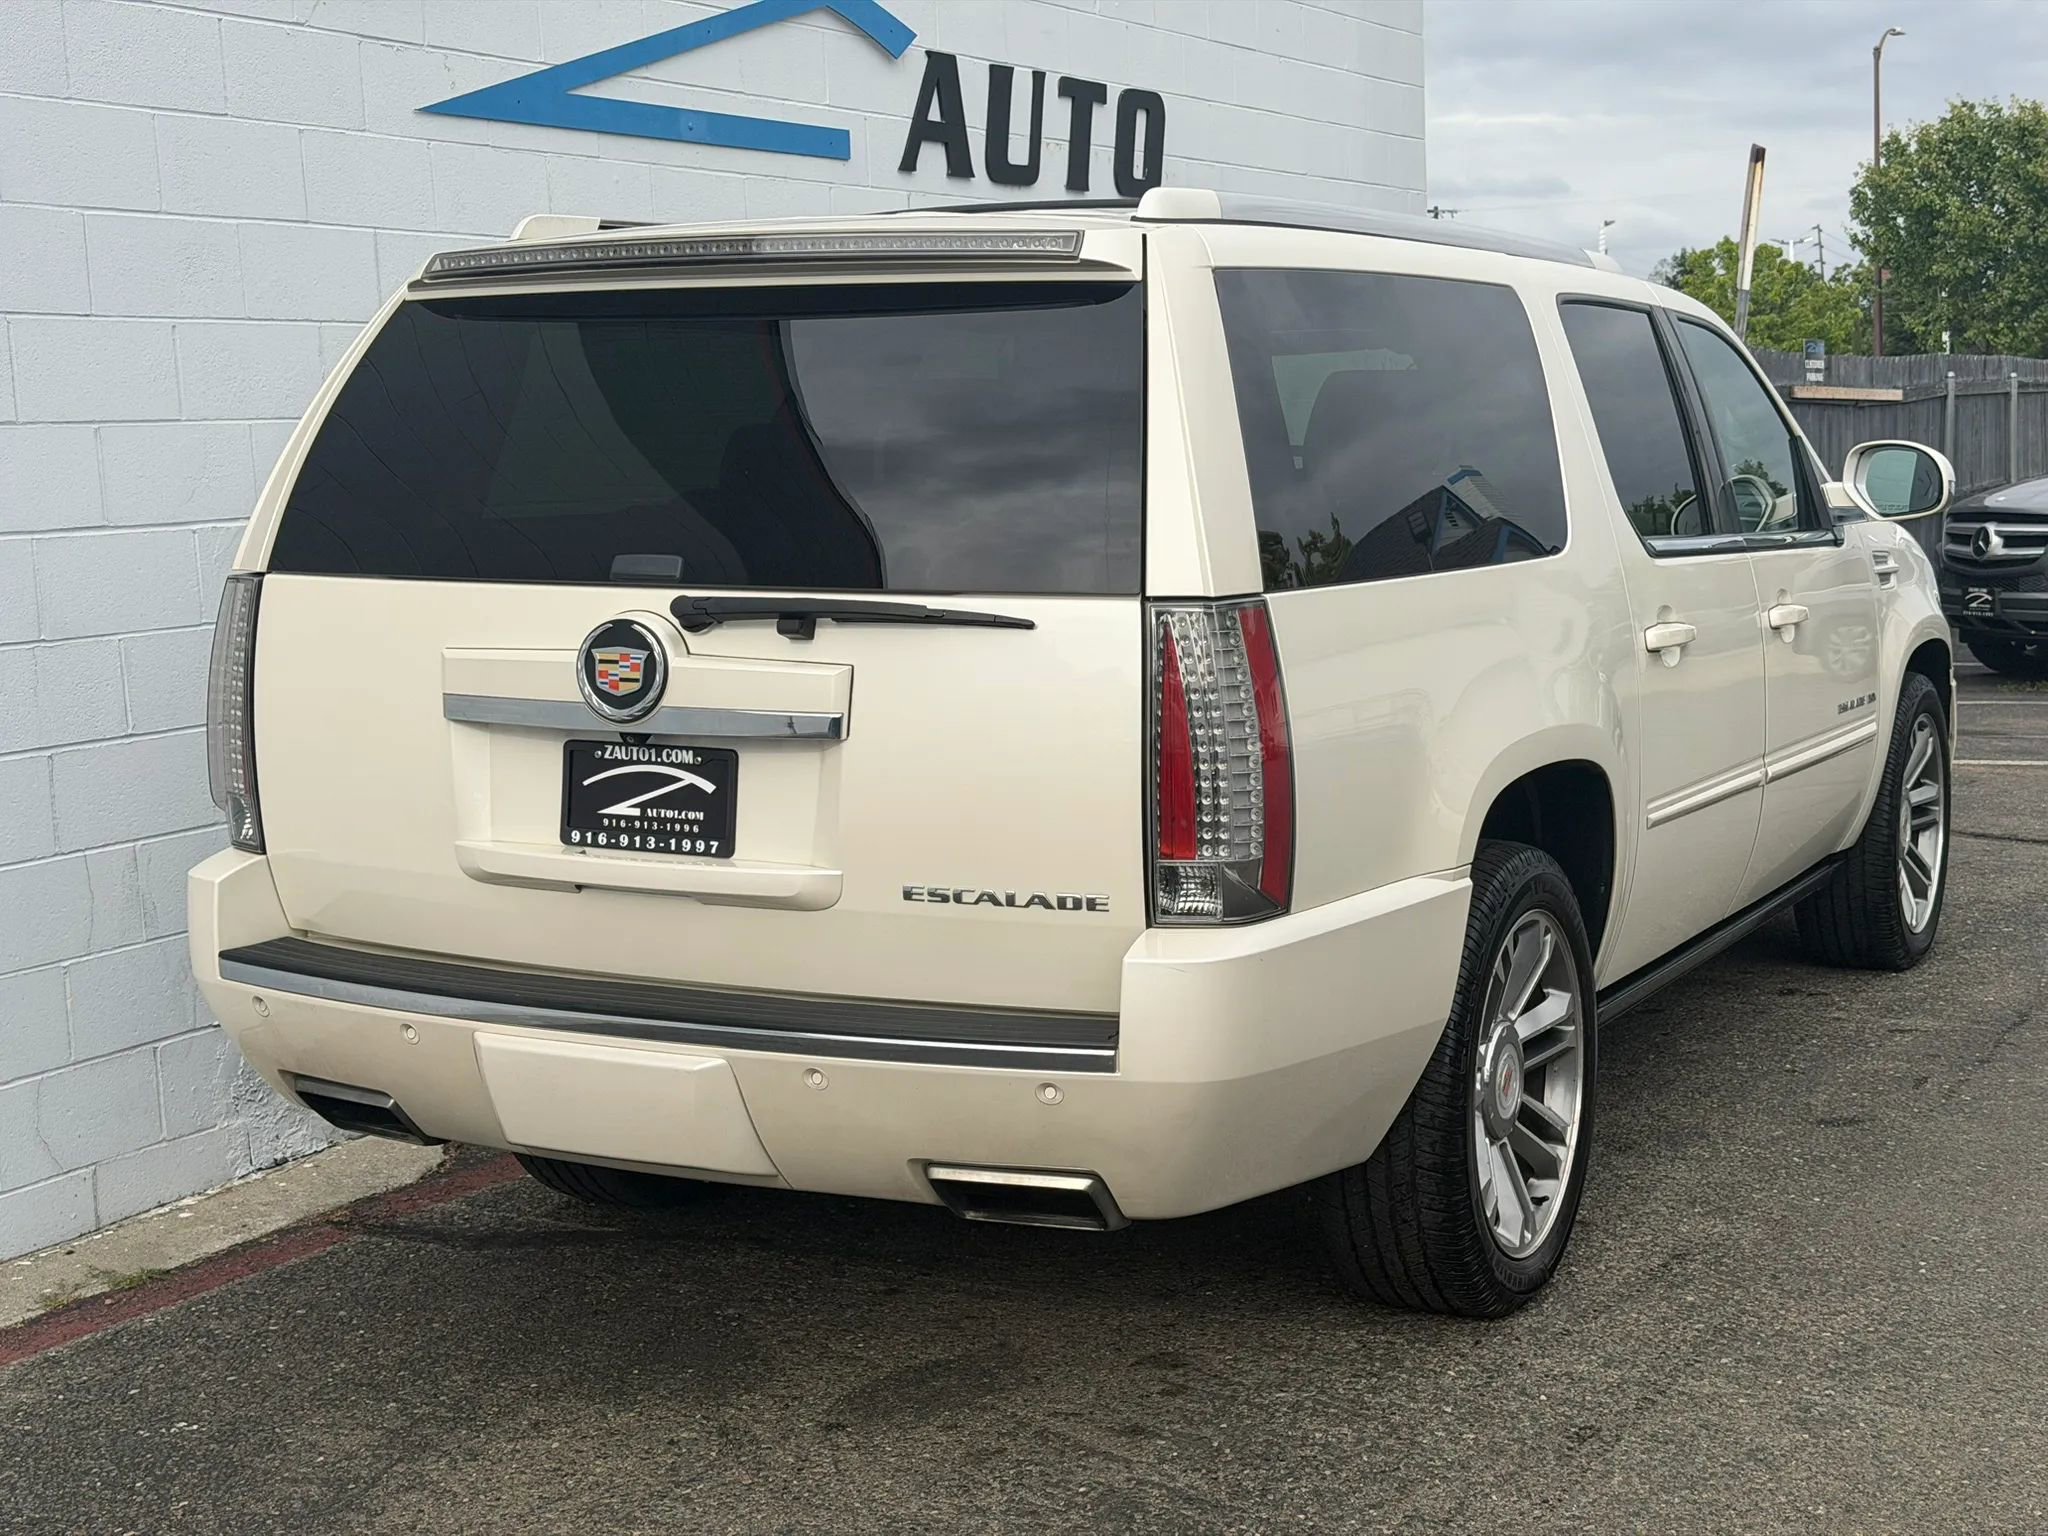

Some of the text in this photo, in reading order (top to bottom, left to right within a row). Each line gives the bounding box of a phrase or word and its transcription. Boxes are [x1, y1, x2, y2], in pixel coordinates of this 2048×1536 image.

[898, 50, 1166, 198] AUTO
[603, 745, 693, 764] ZAUTO1.COM
[645, 807, 704, 821] AUTO1.COM
[603, 818, 699, 834] 916-913-1996
[571, 830, 719, 855] 916-913-1997
[902, 885, 1110, 912] ESCALADE
